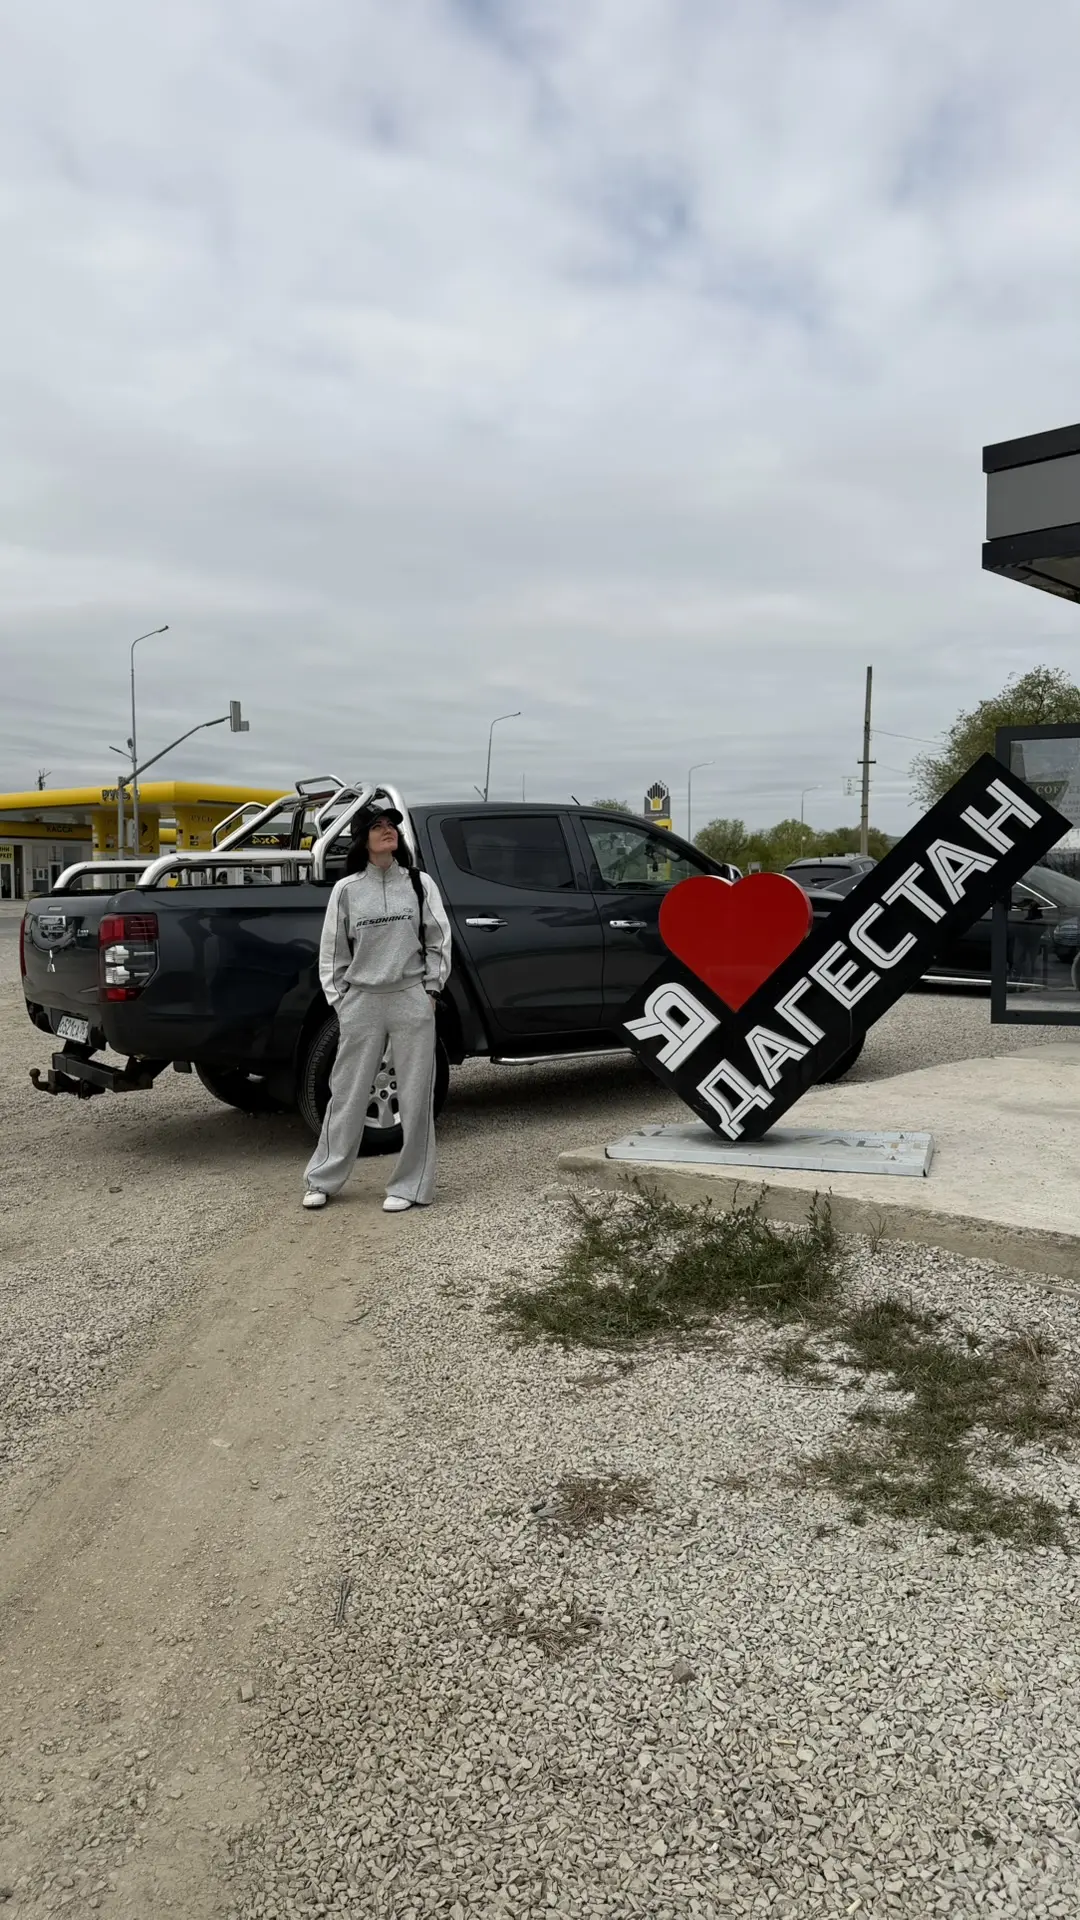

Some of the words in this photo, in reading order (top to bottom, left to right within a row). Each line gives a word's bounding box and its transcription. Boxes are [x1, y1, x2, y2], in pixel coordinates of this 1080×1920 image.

[46, 824, 73, 833] КАССА
[356, 914, 414, 928] RESONANCE
[696, 778, 1042, 1140] ДАГЕСТАН
[622, 982, 721, 1072] Я
